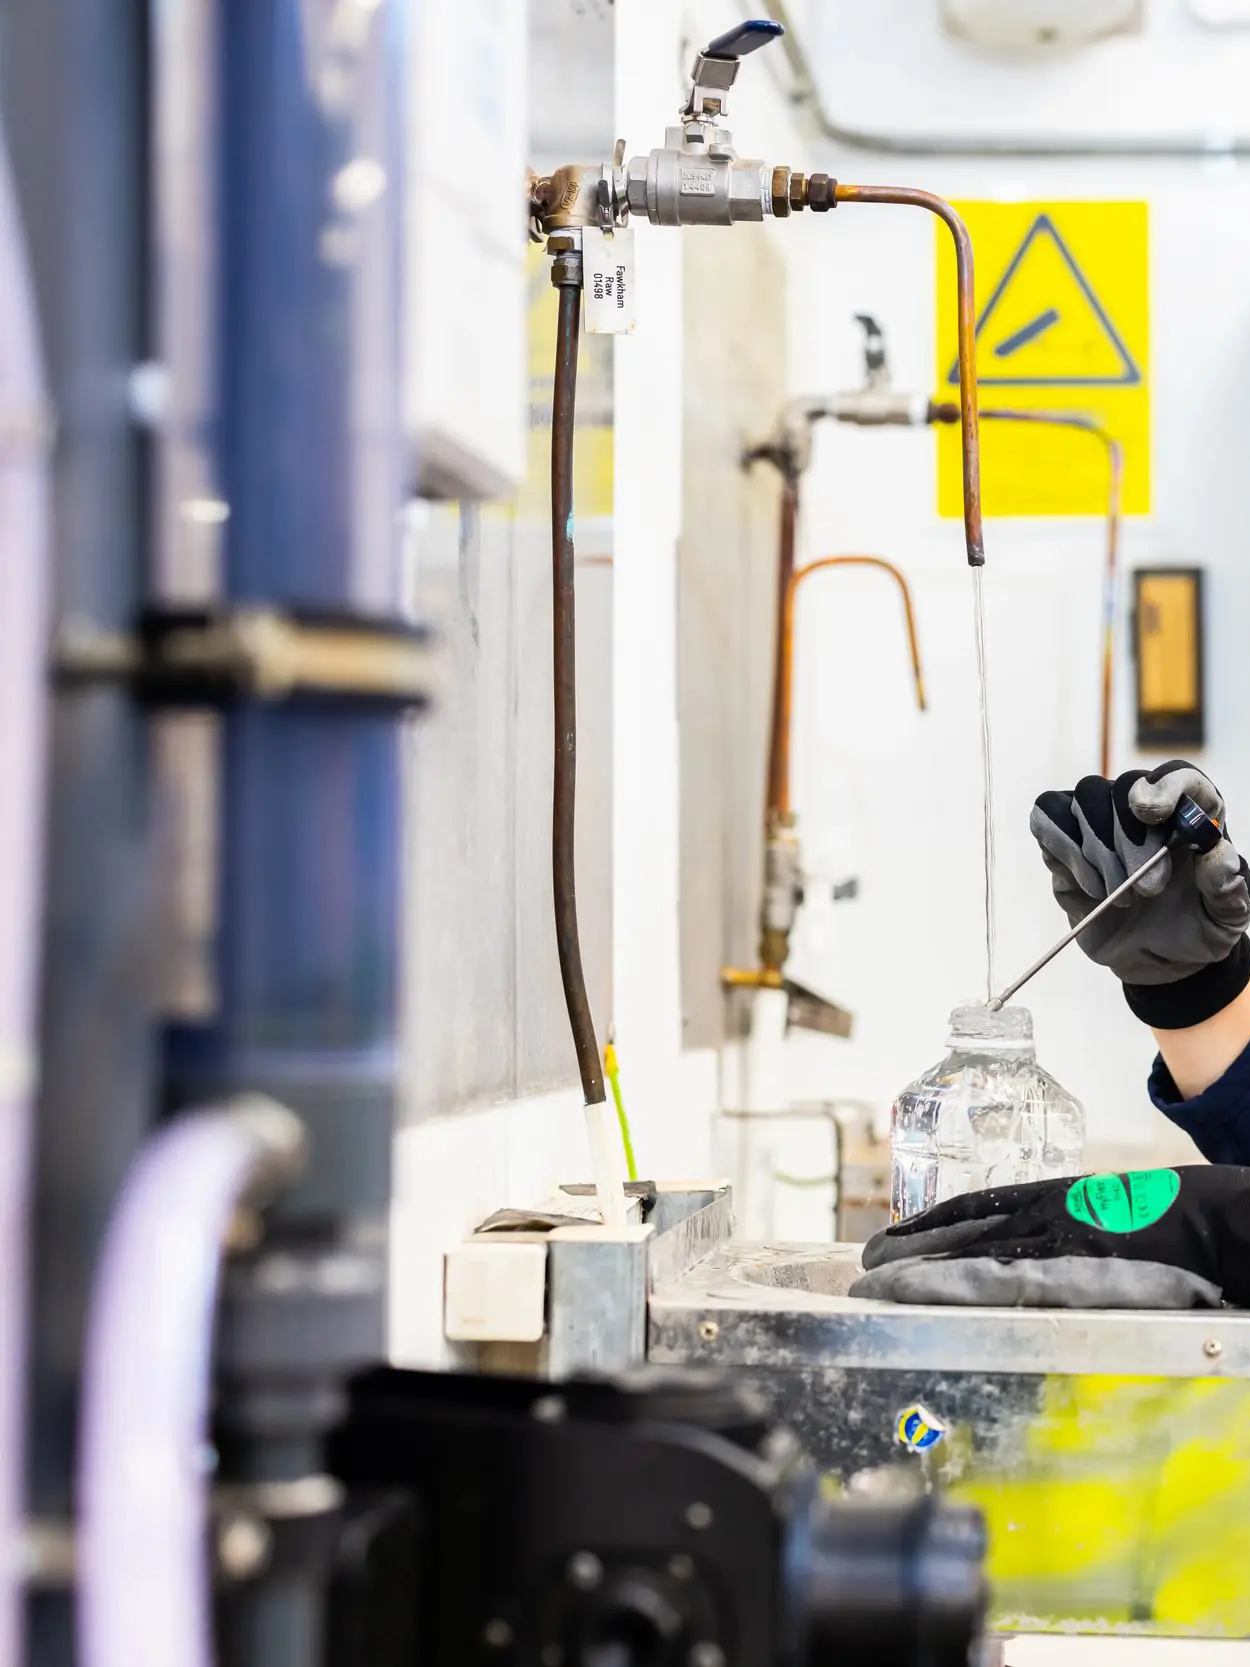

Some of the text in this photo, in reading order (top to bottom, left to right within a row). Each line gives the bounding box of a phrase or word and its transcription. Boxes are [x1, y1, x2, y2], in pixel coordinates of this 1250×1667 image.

[593, 273, 603, 299] 01498
[605, 276, 614, 296] Raw
[616, 265, 626, 309] Fawkham
